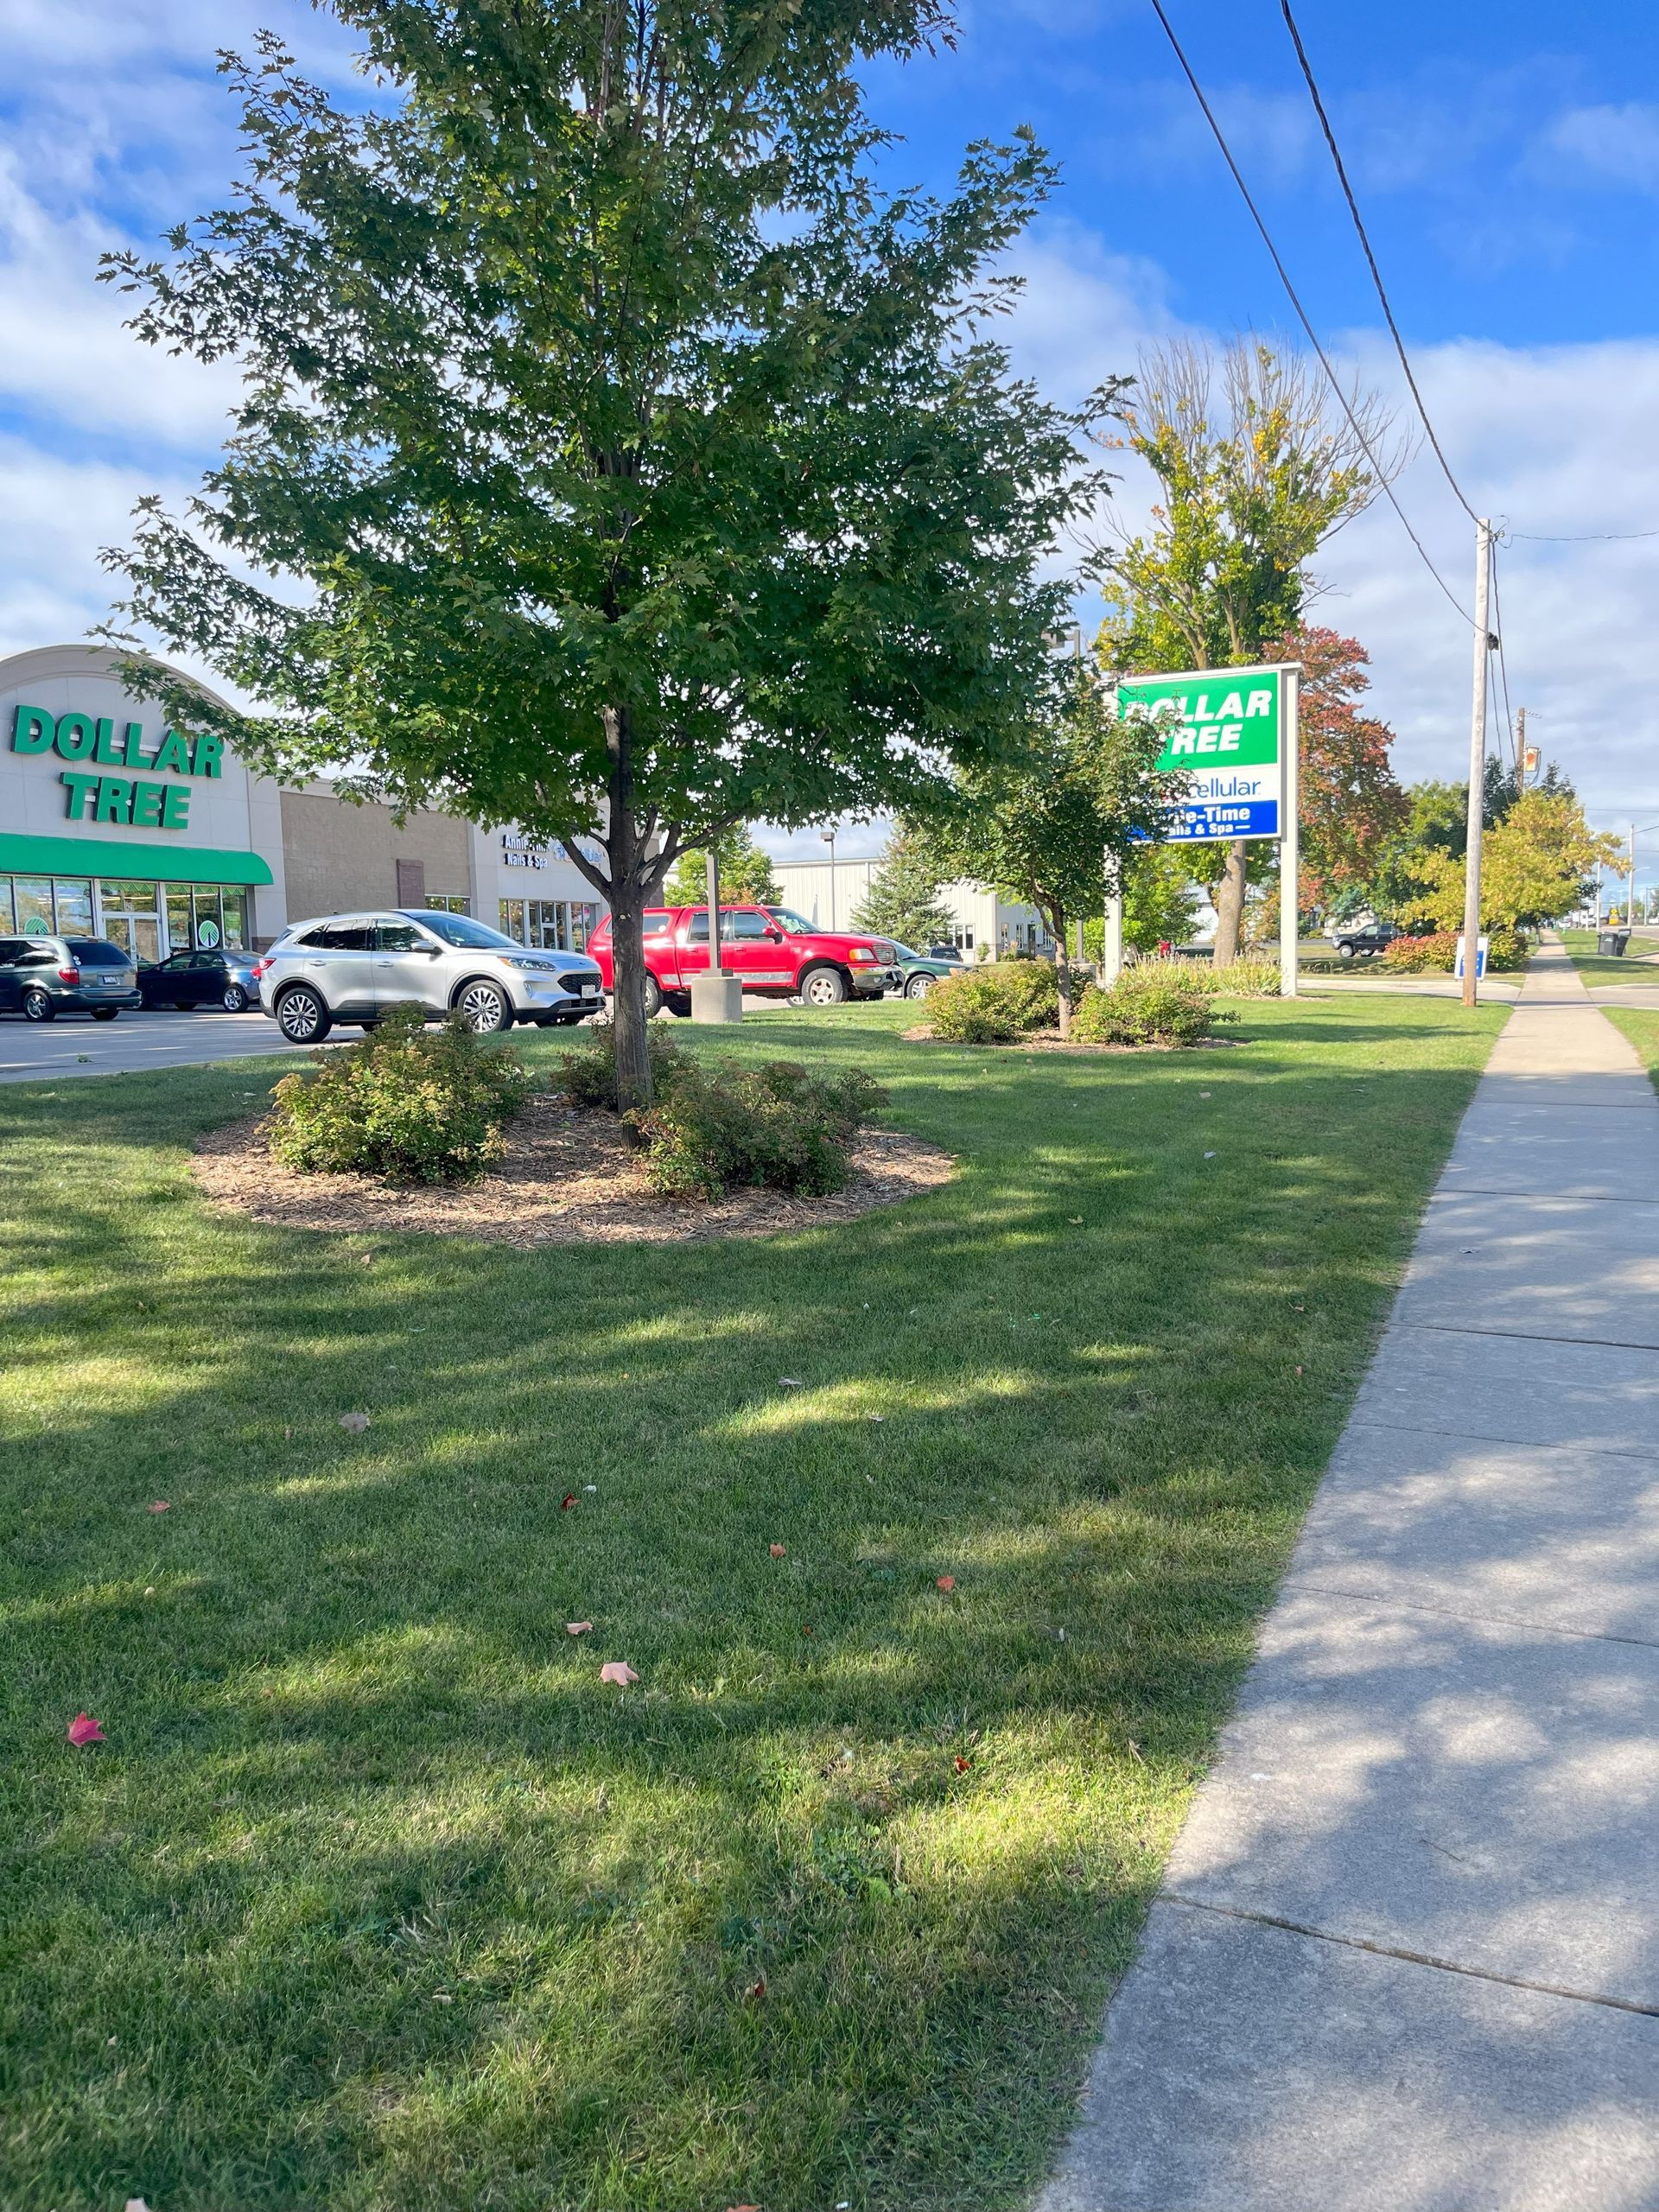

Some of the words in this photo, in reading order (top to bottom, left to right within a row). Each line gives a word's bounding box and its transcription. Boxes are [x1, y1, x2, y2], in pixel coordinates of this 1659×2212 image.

[1122, 690, 1273, 725] DOLLAR
[10, 704, 225, 779] DOLLAR
[1159, 723, 1243, 755] REE
[60, 772, 193, 830] TREE
[1163, 777, 1262, 800] cellular
[1160, 824, 1192, 836] ails
[1195, 823, 1205, 835] &
[1208, 823, 1234, 836] Spa
[1162, 806, 1251, 826] ie-Time
[506, 853, 526, 867] Nails
[527, 854, 534, 867] &
[534, 855, 548, 869] Spa
